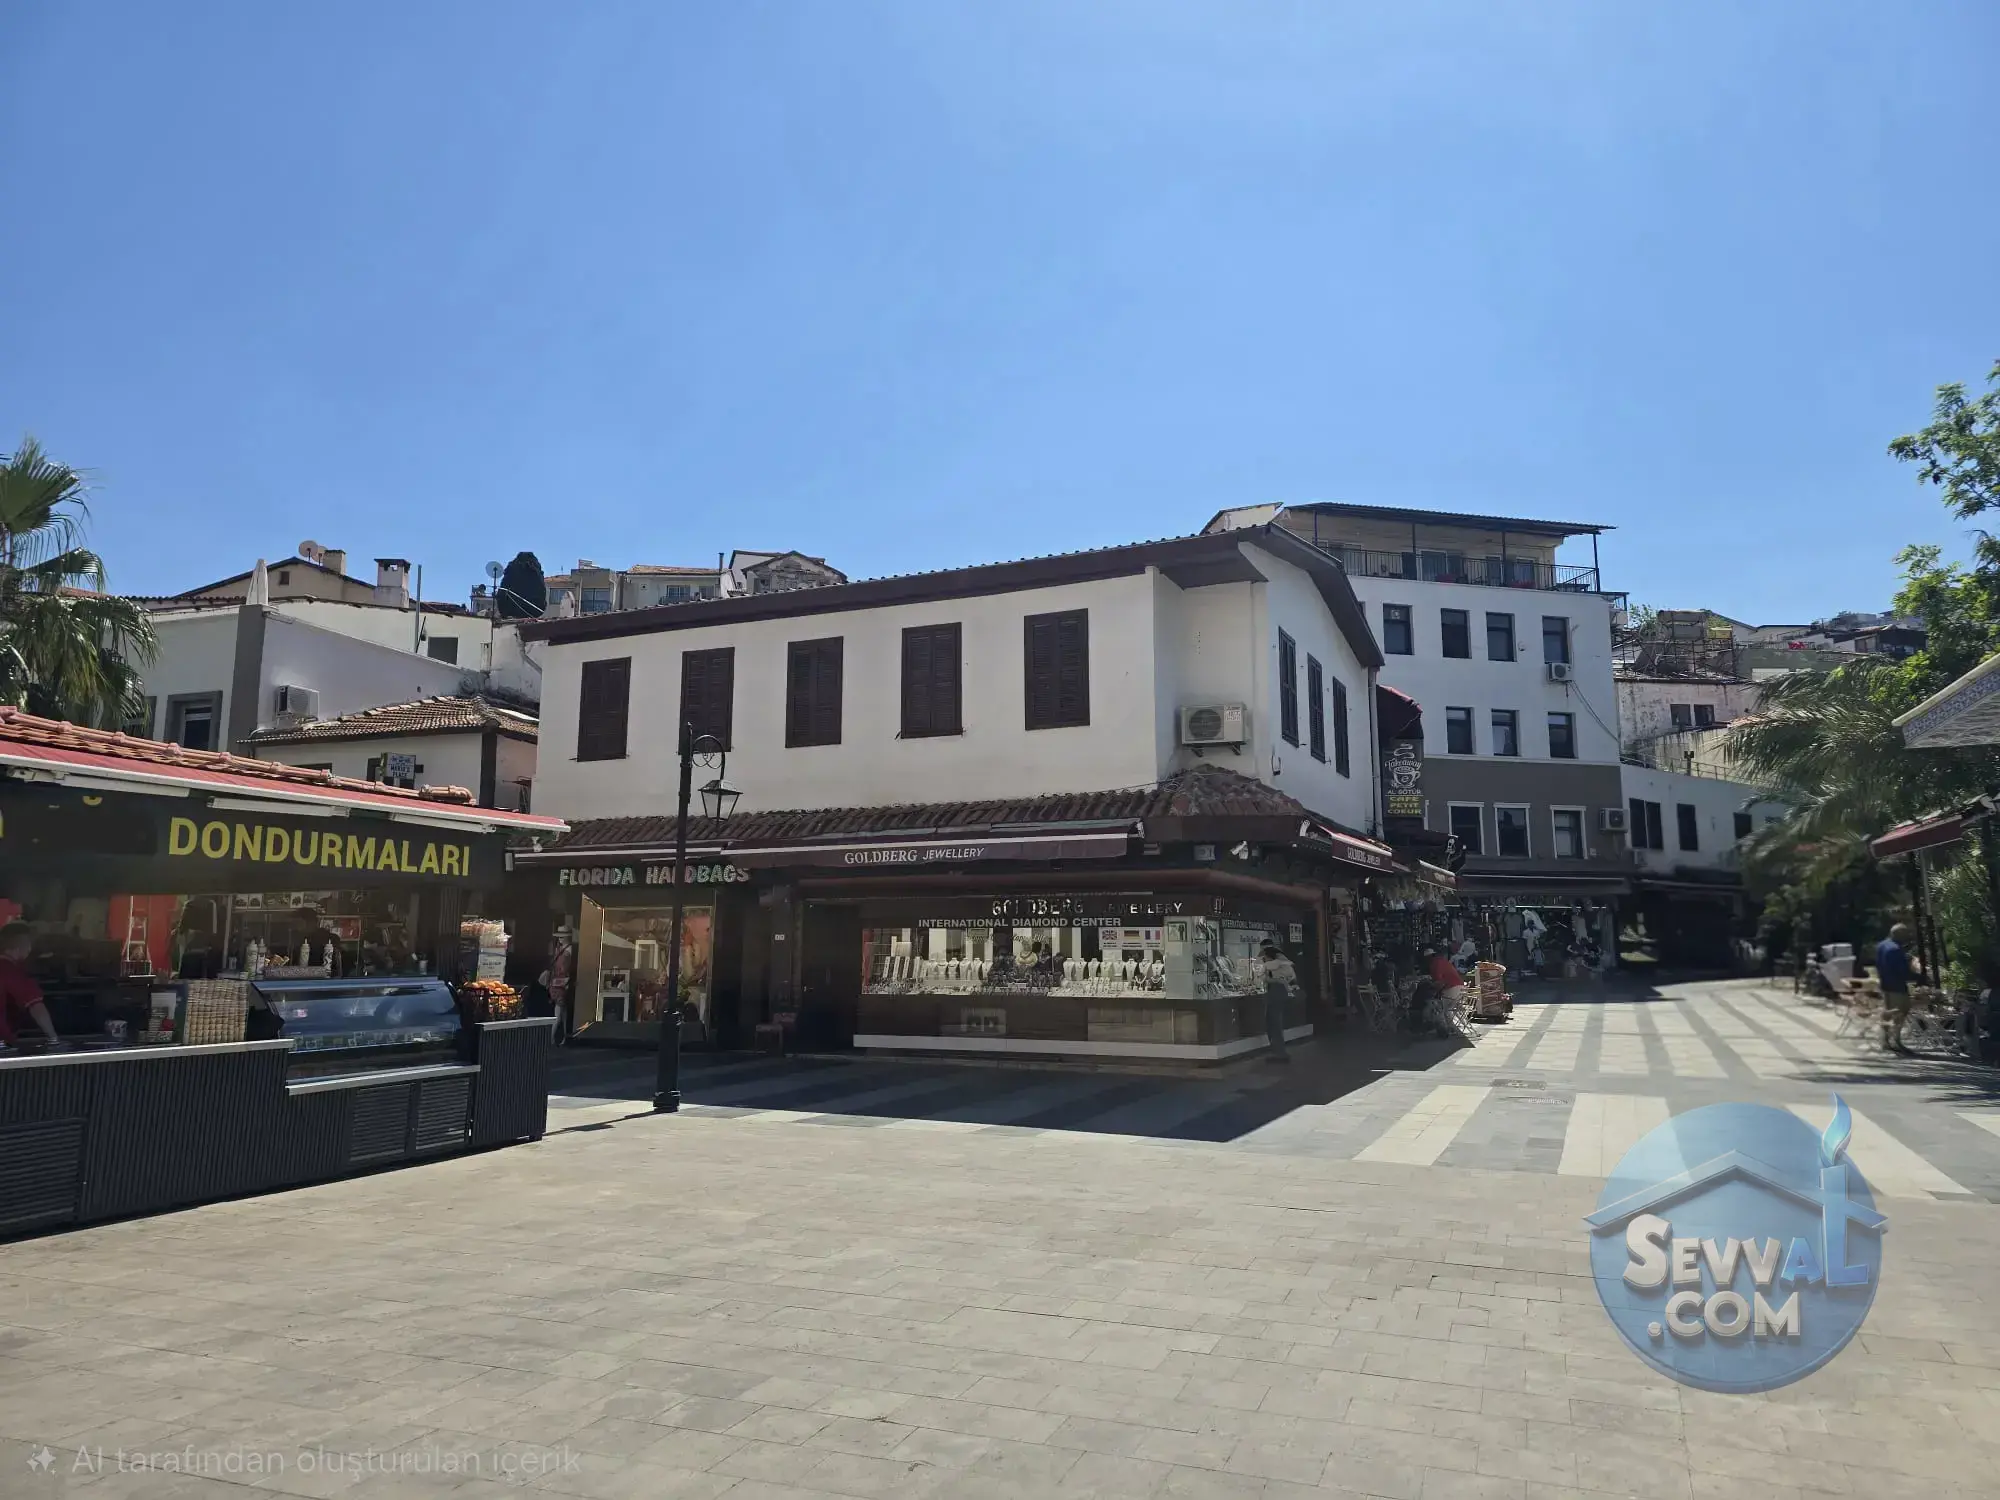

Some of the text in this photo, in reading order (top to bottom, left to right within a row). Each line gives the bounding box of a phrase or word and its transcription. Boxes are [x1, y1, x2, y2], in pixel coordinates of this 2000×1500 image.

[169, 816, 470, 876] DONDURMALARI
[844, 847, 985, 864] GOLDBERG JEWELLERY
[560, 867, 634, 886] FLORIDA
[918, 917, 1122, 928] INTERNATIONAL DIAMOND CENTER
